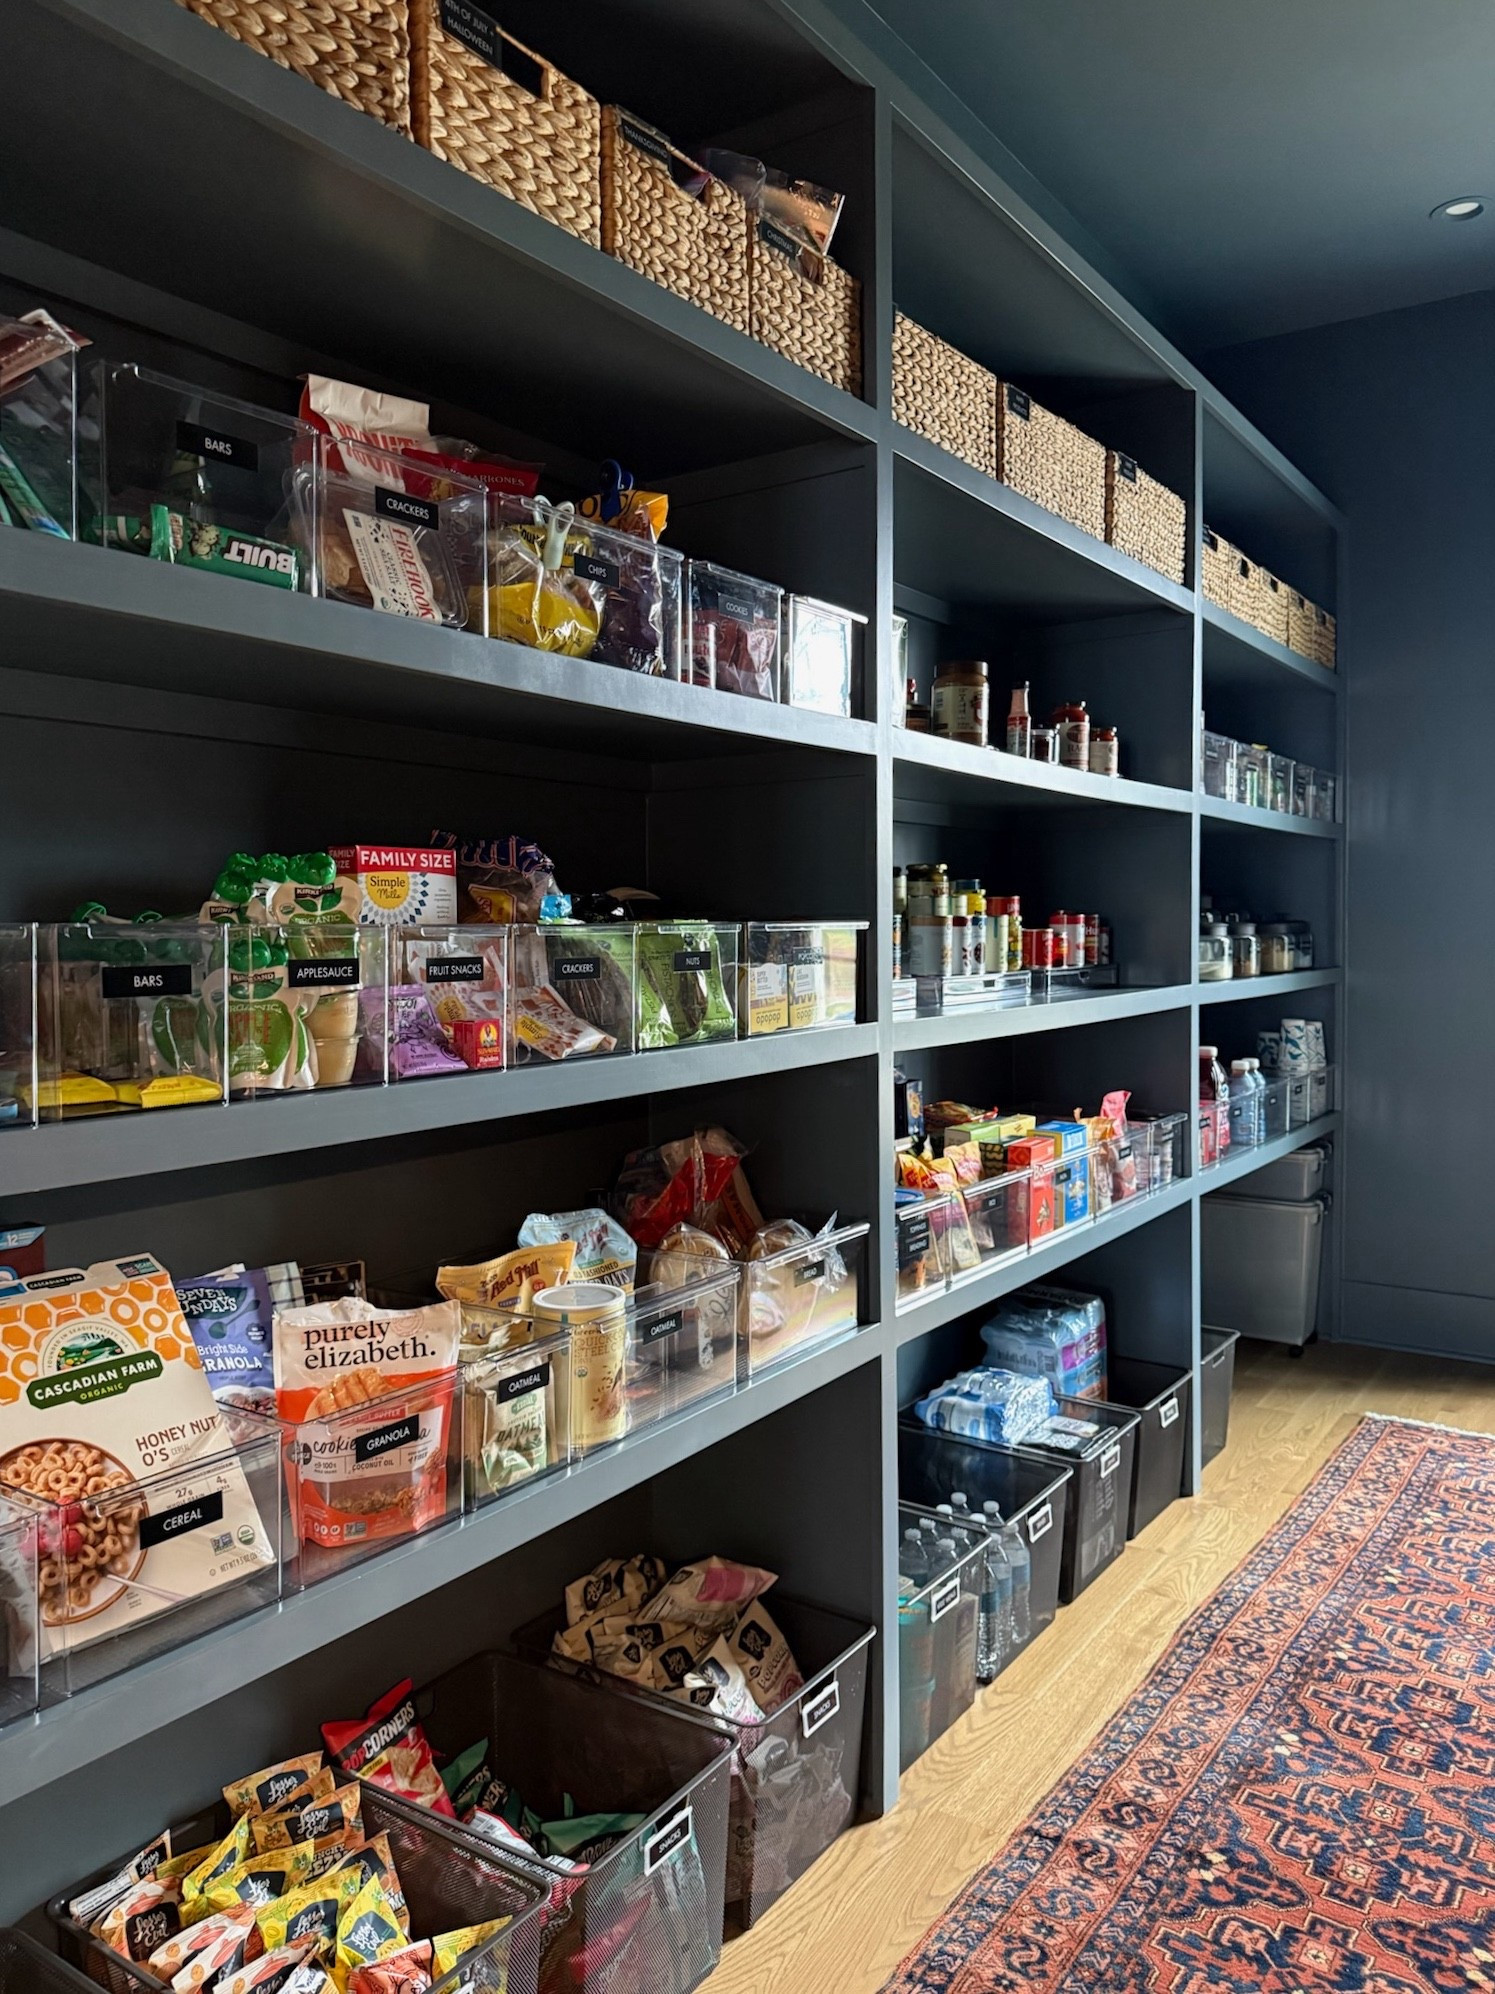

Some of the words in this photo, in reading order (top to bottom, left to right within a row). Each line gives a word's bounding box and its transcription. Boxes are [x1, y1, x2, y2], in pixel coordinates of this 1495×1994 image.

[461, 8, 471, 20] OF
[473, 17, 488, 33] JULY
[447, 16, 493, 55] HALLOWEEN
[624, 125, 668, 158] THANKSGIVING
[766, 230, 793, 251] CHRISTMAS
[204, 437, 232, 455] BARS
[386, 498, 429, 520] CRACKERS
[223, 541, 294, 574] BUILT
[392, 527, 435, 619] FIREHOOK
[588, 564, 607, 578] CHIPS
[725, 602, 748, 616] COOKIES
[360, 850, 416, 867] FAMILY
[420, 853, 452, 868] SIZE
[370, 876, 406, 889] Simple
[377, 888, 401, 899] Mills
[428, 966, 450, 976] FRUIT
[451, 963, 482, 975] SNACKS
[562, 964, 594, 974] CRACKERS
[685, 957, 700, 966] NUTS
[133, 974, 163, 987] BARS
[296, 966, 353, 979] APPLESAUCE
[756, 1012, 781, 1026] opopop
[6, 1234, 18, 1246] 12
[583, 1261, 619, 1277] FASHIONED
[603, 1269, 630, 1287] OATS
[491, 1271, 515, 1302] Red
[514, 1259, 540, 1288] Mill
[176, 1288, 226, 1301] SEVEN
[179, 1297, 237, 1315] UNDAYS
[304, 1320, 391, 1351] purely
[650, 1318, 677, 1336] OATMEAL
[197, 1343, 228, 1356] Bright
[229, 1344, 248, 1354] Side
[304, 1336, 436, 1370] elizabeth.
[34, 1371, 119, 1400] CASCADIAN
[121, 1358, 158, 1377] FARM
[508, 1373, 541, 1393] OATMEAL
[80, 1382, 124, 1400] ORGANIC
[136, 1424, 186, 1452] HONEY
[190, 1416, 217, 1435] NUT
[366, 1426, 410, 1451] GRANOLA
[313, 1435, 357, 1456] cookie
[142, 1448, 169, 1467] O'S
[352, 1461, 382, 1472] COCONUT
[383, 1459, 394, 1468] OIL
[163, 1508, 203, 1532] CEREAL
[342, 1700, 415, 1771] POPCORNERS
[268, 1775, 298, 1803] Lesser
[298, 1808, 330, 1834] Lesser
[306, 1818, 329, 1838] Evil
[658, 1828, 682, 1853] SNACKS
[134, 1911, 168, 1942] Lesser
[291, 1910, 326, 1939] Lesser
[352, 1921, 374, 1948] Lesser
[144, 1923, 171, 1948] Evil
[361, 1932, 384, 1951] Evil
